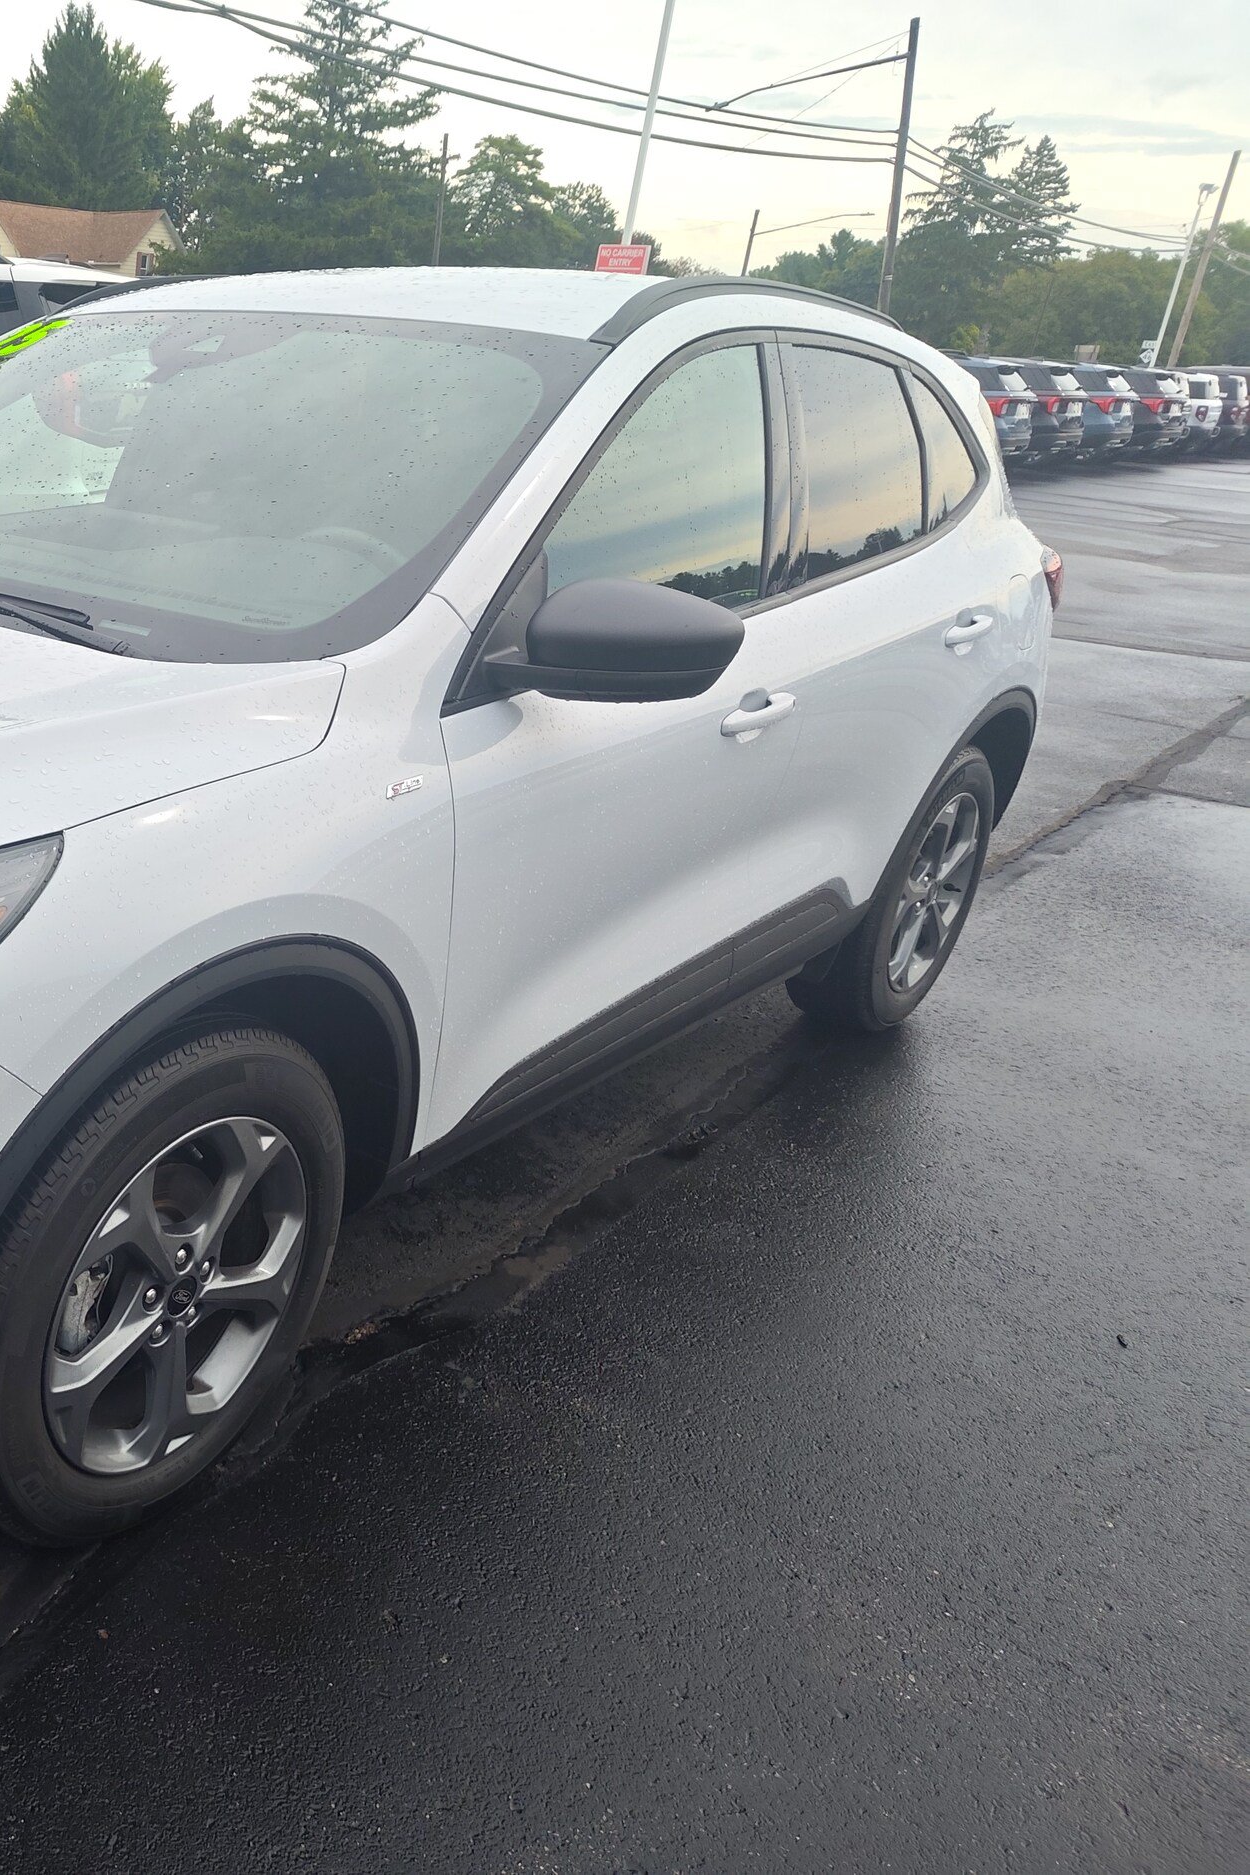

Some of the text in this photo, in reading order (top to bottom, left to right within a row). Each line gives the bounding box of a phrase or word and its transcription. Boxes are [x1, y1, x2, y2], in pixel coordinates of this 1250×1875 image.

[600, 248, 644, 257] NO CARRIER
[608, 257, 633, 266] ENTRY
